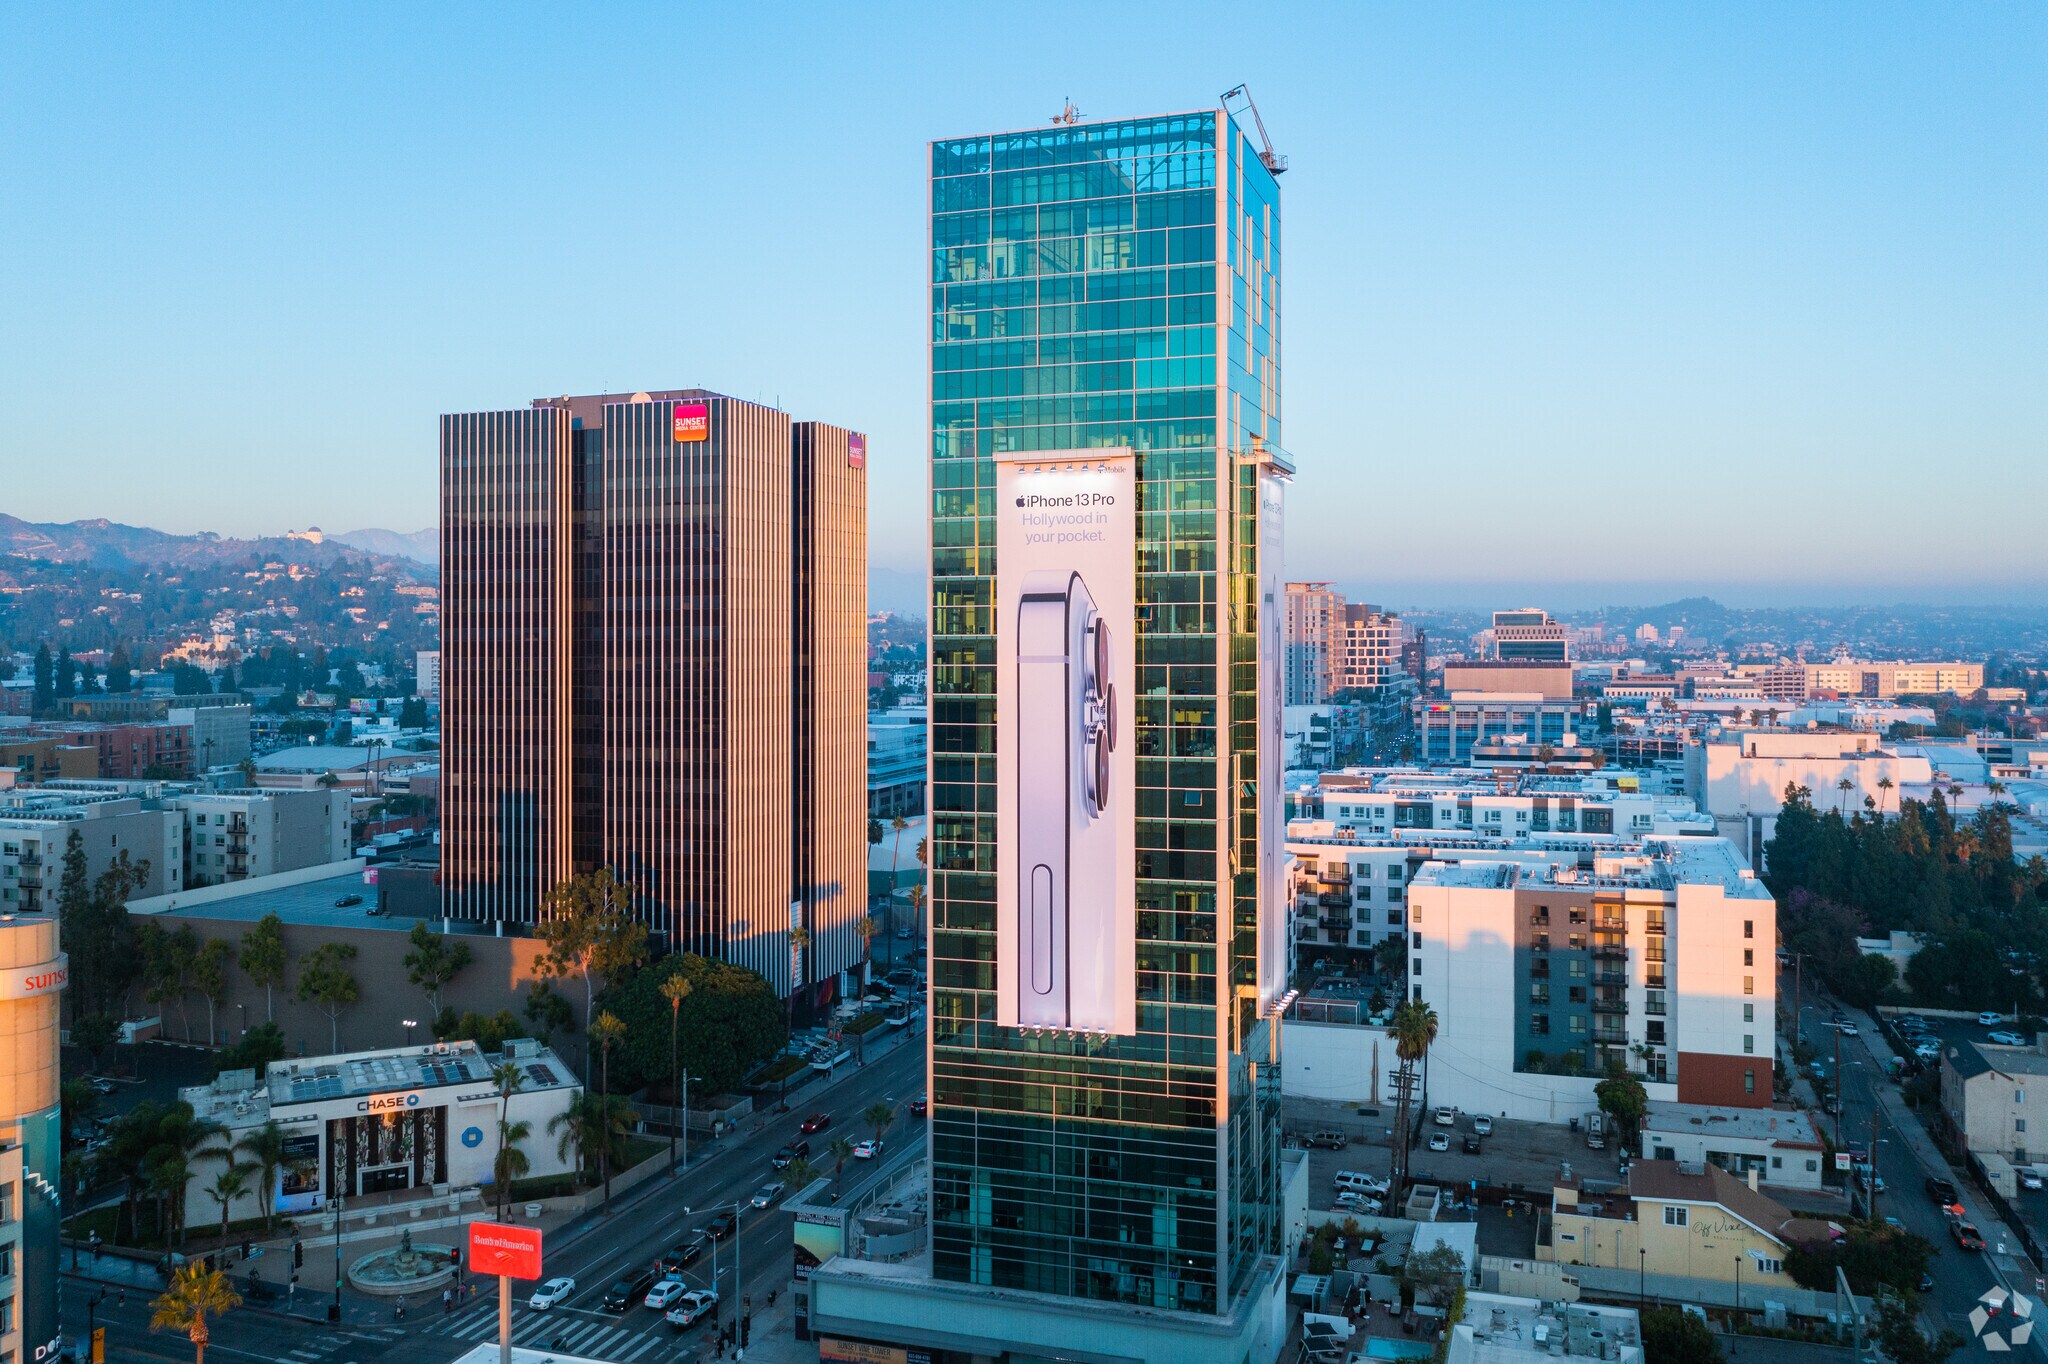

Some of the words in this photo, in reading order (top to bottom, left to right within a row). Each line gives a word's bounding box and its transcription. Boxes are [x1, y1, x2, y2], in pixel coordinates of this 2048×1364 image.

[675, 416, 706, 427] SUNSET
[1026, 494, 1073, 507] iPhone
[1075, 493, 1090, 506] 13
[1092, 493, 1115, 506] Pro
[1022, 511, 1093, 528] Hollywood
[1096, 511, 1108, 524] in
[1025, 531, 1055, 546] your
[1057, 529, 1106, 544] pocket.
[357, 1096, 405, 1112] CHASE
[473, 1234, 494, 1246] Bank
[494, 1237, 503, 1247] of
[502, 1239, 534, 1252] America
[837, 1340, 857, 1351] SUNSET
[858, 1344, 870, 1353] VINE
[872, 1346, 891, 1356] TOWER
